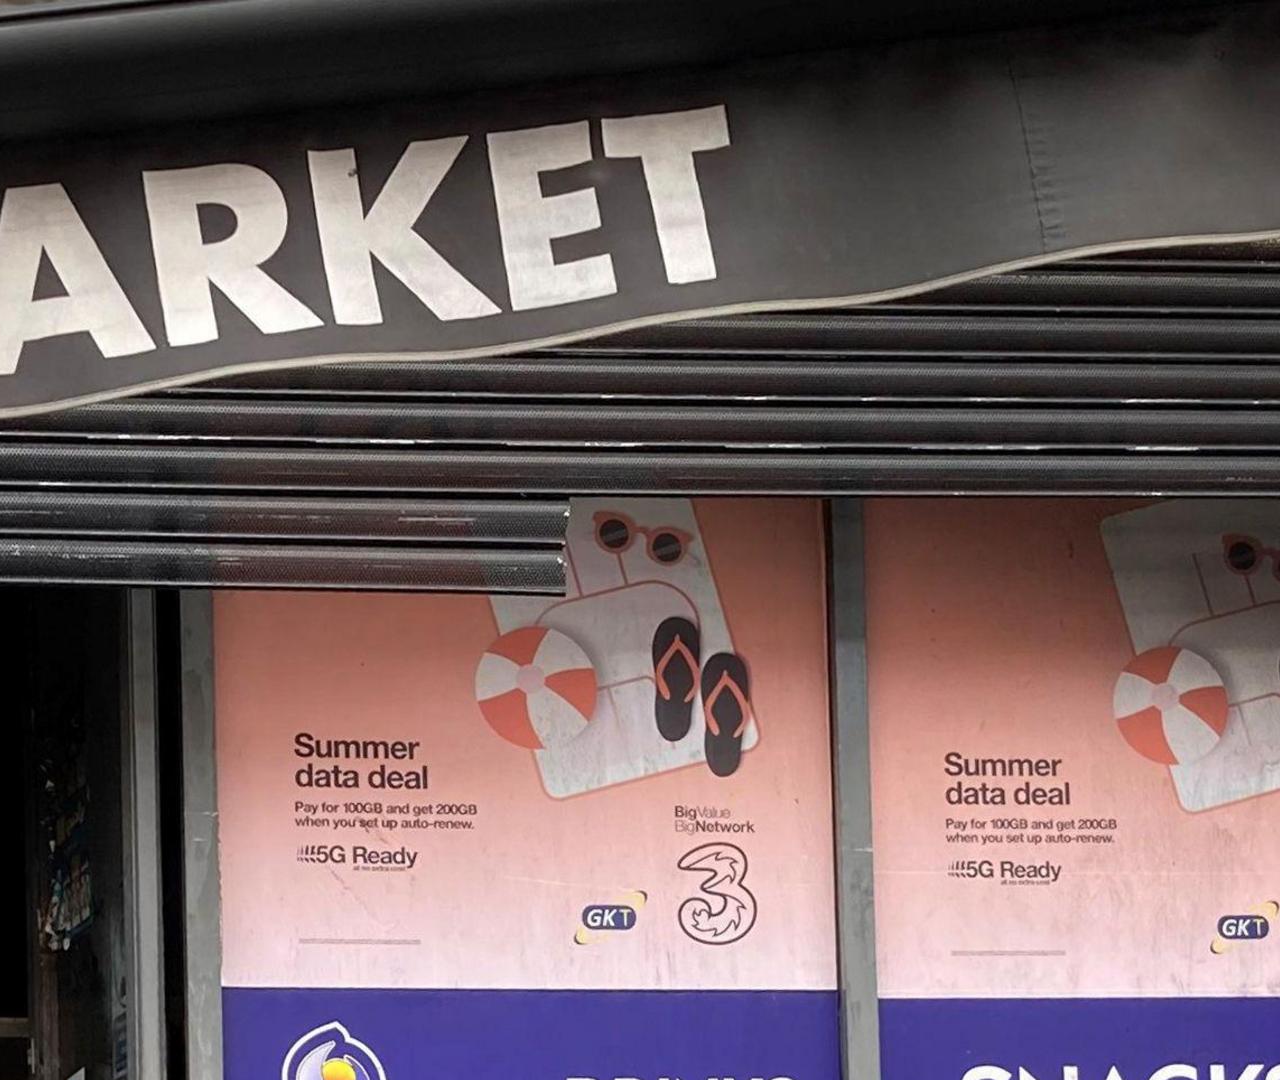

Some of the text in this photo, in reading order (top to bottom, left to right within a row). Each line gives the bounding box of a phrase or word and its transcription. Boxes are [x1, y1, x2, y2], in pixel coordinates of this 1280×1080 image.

[293, 732, 420, 760] Summer
[944, 751, 1063, 777] Summer
[294, 762, 429, 790] data deal
[945, 781, 1071, 806] data deal
[294, 801, 478, 817] Pay for 100GB and get 200GB
[294, 816, 475, 831] when you set up auto-renew.
[674, 819, 757, 835] BigNetwork
[945, 817, 1118, 833] Pay for 100GB and get 200GB
[945, 832, 1116, 846] when you set up auto-renew.
[316, 845, 419, 869] 5G Ready
[965, 860, 1062, 883] 5G Ready
[586, 908, 634, 928] GKT
[1221, 918, 1266, 937] GKT
